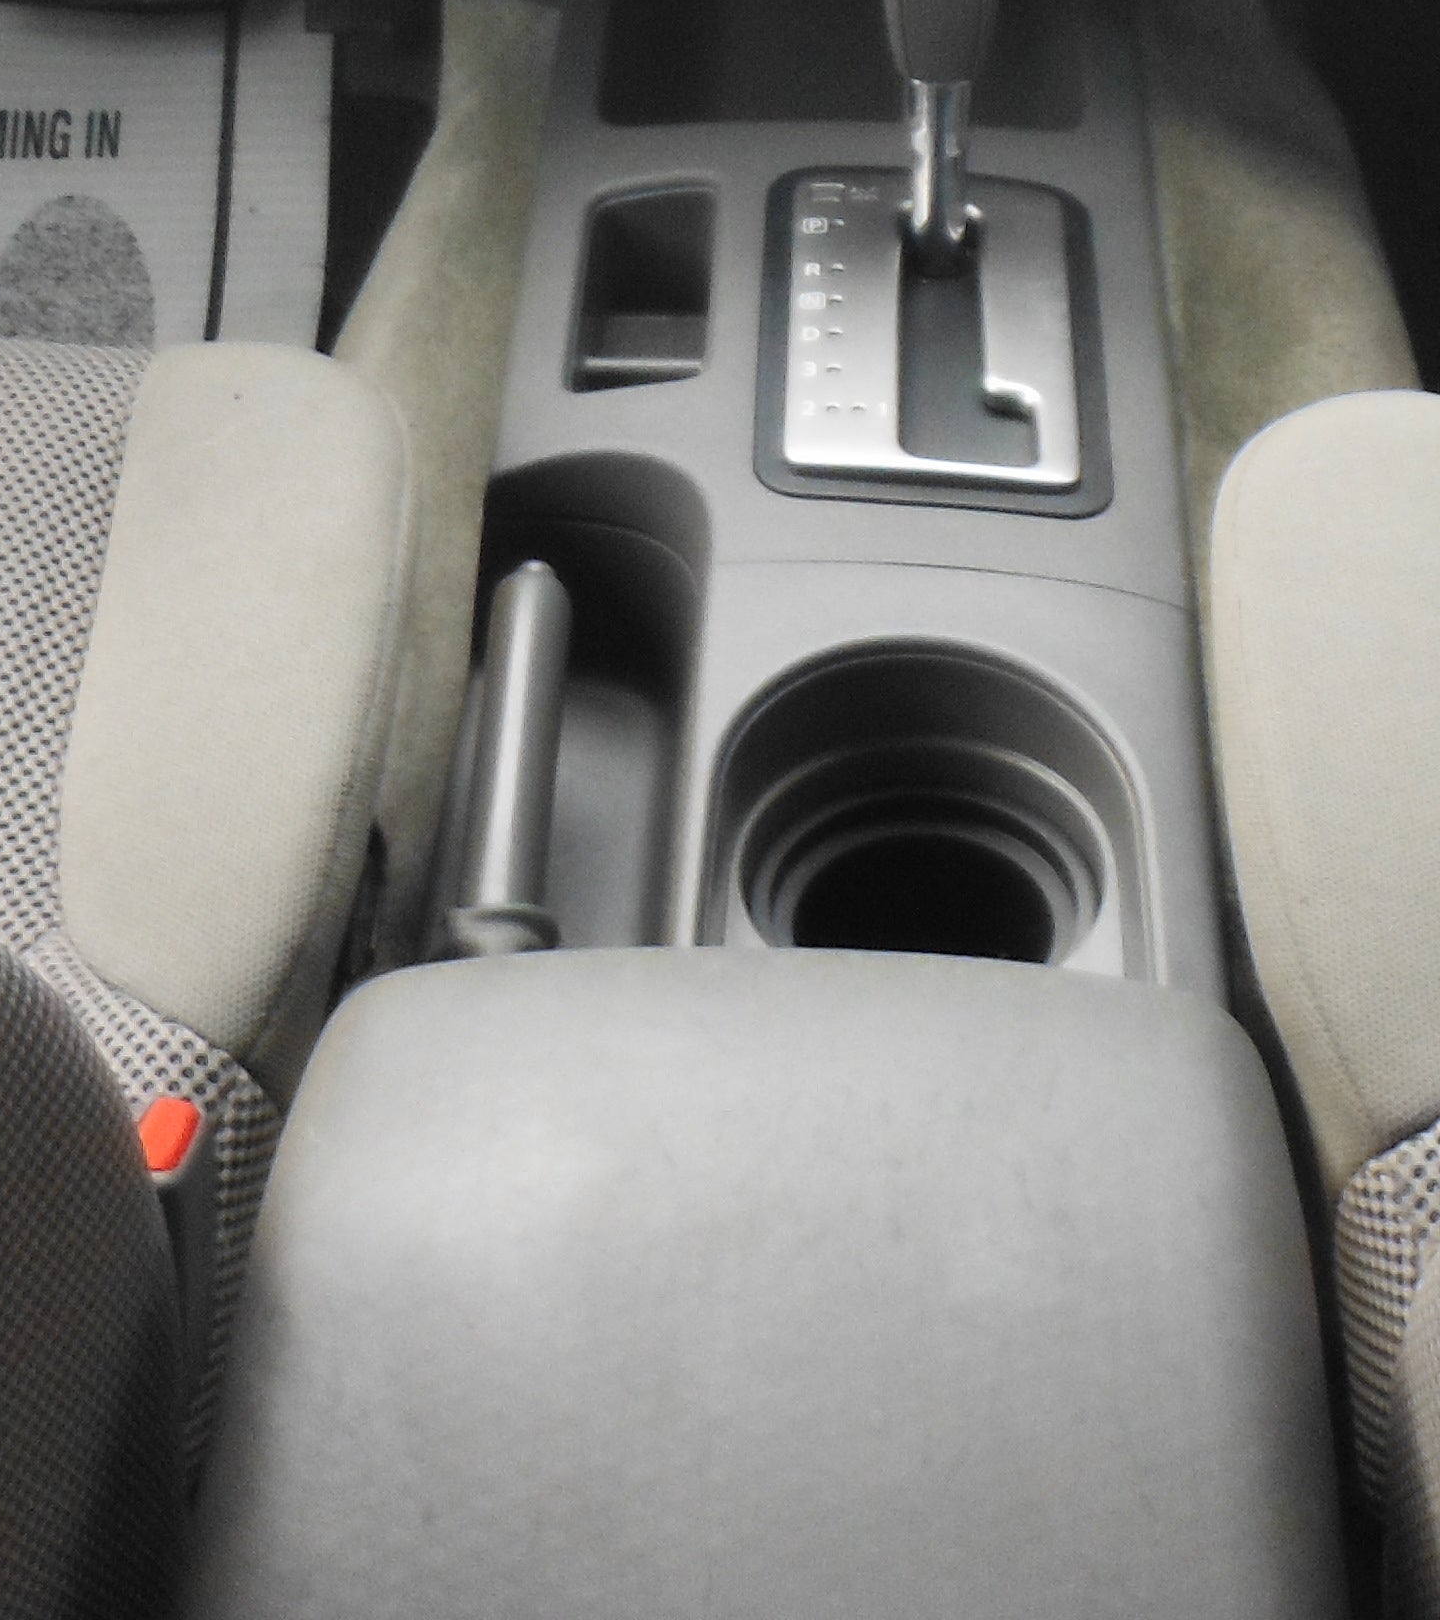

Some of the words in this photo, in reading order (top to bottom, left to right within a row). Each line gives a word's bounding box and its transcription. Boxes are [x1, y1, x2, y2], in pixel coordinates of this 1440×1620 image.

[84, 109, 122, 159] IN
[804, 262, 821, 276] R
[802, 326, 820, 341] D
